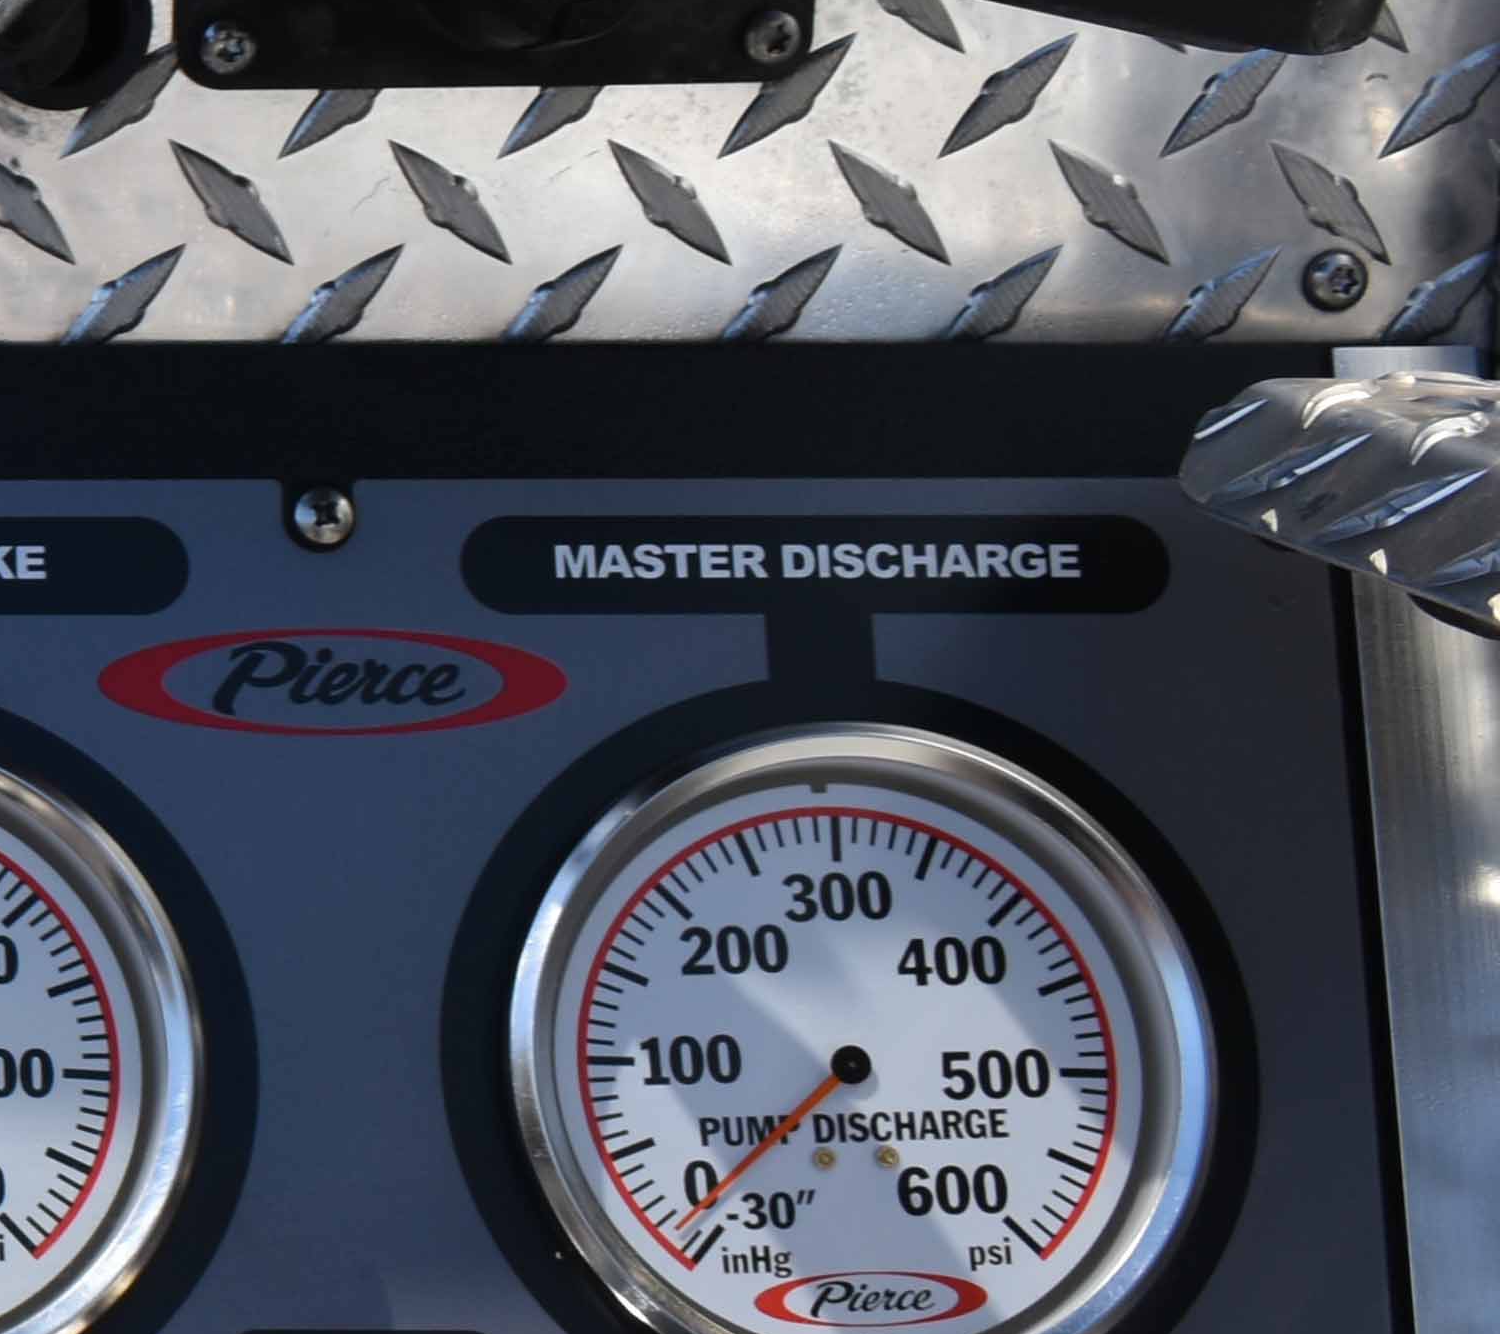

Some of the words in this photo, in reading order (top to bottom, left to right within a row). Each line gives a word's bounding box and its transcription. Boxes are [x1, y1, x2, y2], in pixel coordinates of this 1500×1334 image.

[555, 544, 768, 579] MASTER
[782, 544, 1080, 579] DISCHARGE
[211, 640, 467, 717] Pierce
[782, 872, 892, 921] 300
[680, 926, 788, 975] 200
[898, 936, 1006, 985] 400
[640, 1034, 741, 1085] 100
[941, 1049, 1050, 1099] 500
[700, 1115, 800, 1147] PUMP
[814, 1109, 1010, 1142] DISCHARGE
[684, 1160, 719, 1210] 0
[898, 1165, 1008, 1215] 600
[721, 1245, 793, 1278] inHg
[968, 1239, 1013, 1272] psi
[812, 1280, 936, 1316] Pierce
